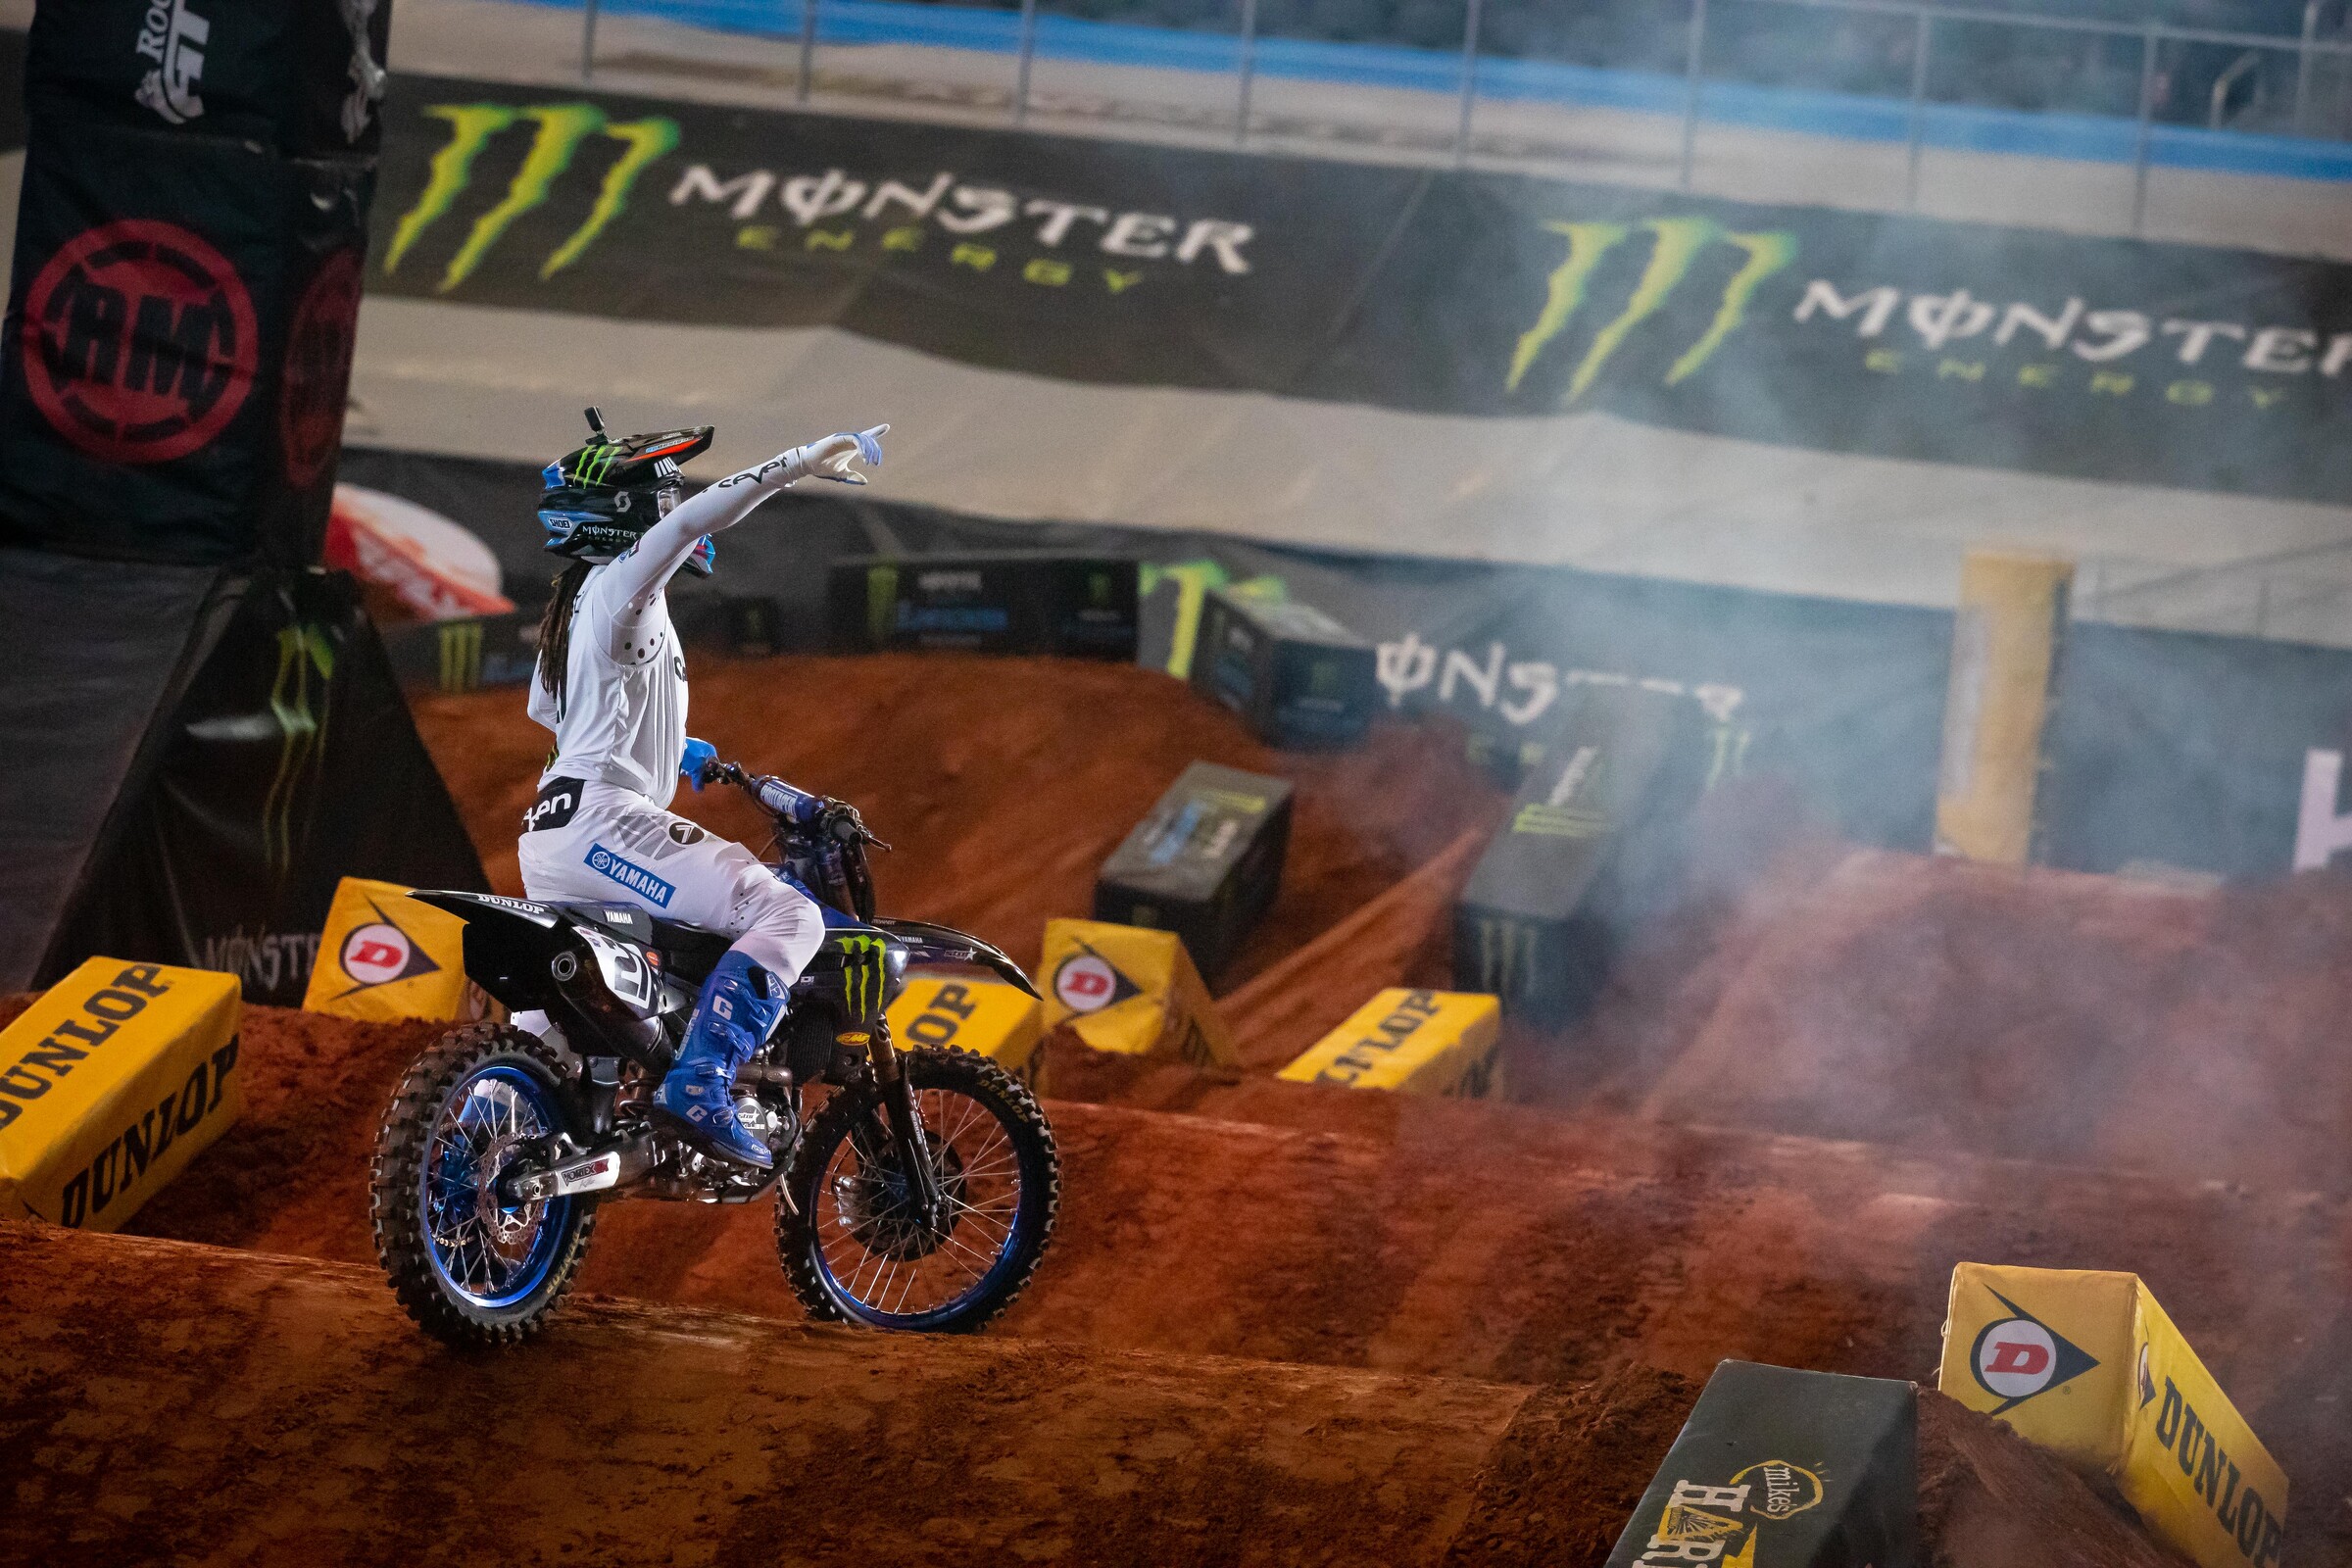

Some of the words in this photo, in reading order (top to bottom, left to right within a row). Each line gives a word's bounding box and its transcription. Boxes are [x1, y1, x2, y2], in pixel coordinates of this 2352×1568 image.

[670, 163, 1253, 275] MONSTER
[736, 225, 1145, 294] ENERGY
[549, 516, 571, 530] SHOEI
[582, 524, 638, 541] MONSTER
[610, 858, 669, 904] YAMAHA
[477, 895, 545, 914] DUNLOP
[605, 910, 633, 925] YAMAHA
[350, 940, 403, 968] D
[60, 1032, 238, 1230] DUNLOP
[562, 1162, 597, 1187] VORTEX
[1984, 1341, 2049, 1375] D
[2155, 1374, 2283, 1568] DUNLOP
[1631, 1480, 1752, 1568] HAR
